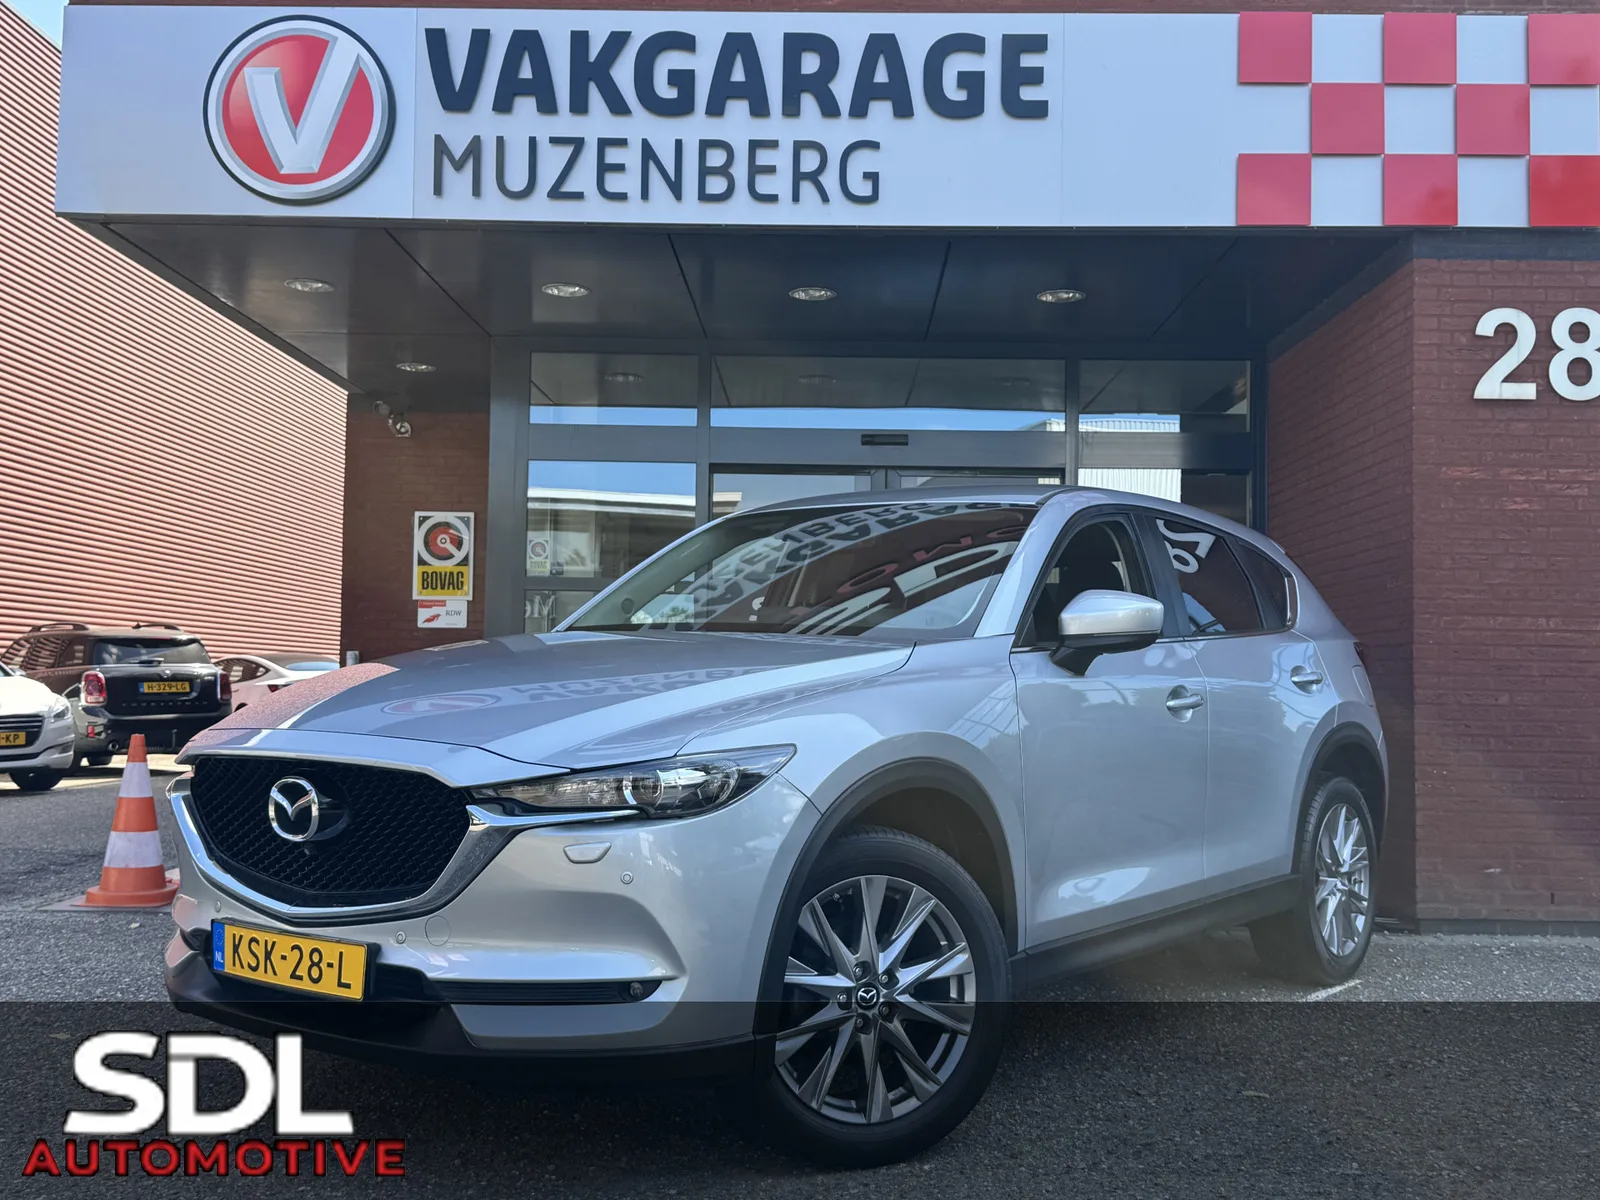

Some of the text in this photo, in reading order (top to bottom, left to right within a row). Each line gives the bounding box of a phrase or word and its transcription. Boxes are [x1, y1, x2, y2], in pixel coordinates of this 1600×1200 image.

[425, 27, 1050, 119] VAKGARAGE
[432, 134, 882, 205] MUZENBERG
[1473, 307, 1600, 401] 28
[421, 571, 465, 591] BOVAG
[445, 609, 462, 617] RDW
[147, 683, 187, 691] H-329-LG
[215, 950, 224, 963] NL
[232, 932, 352, 990] KSK-28-L
